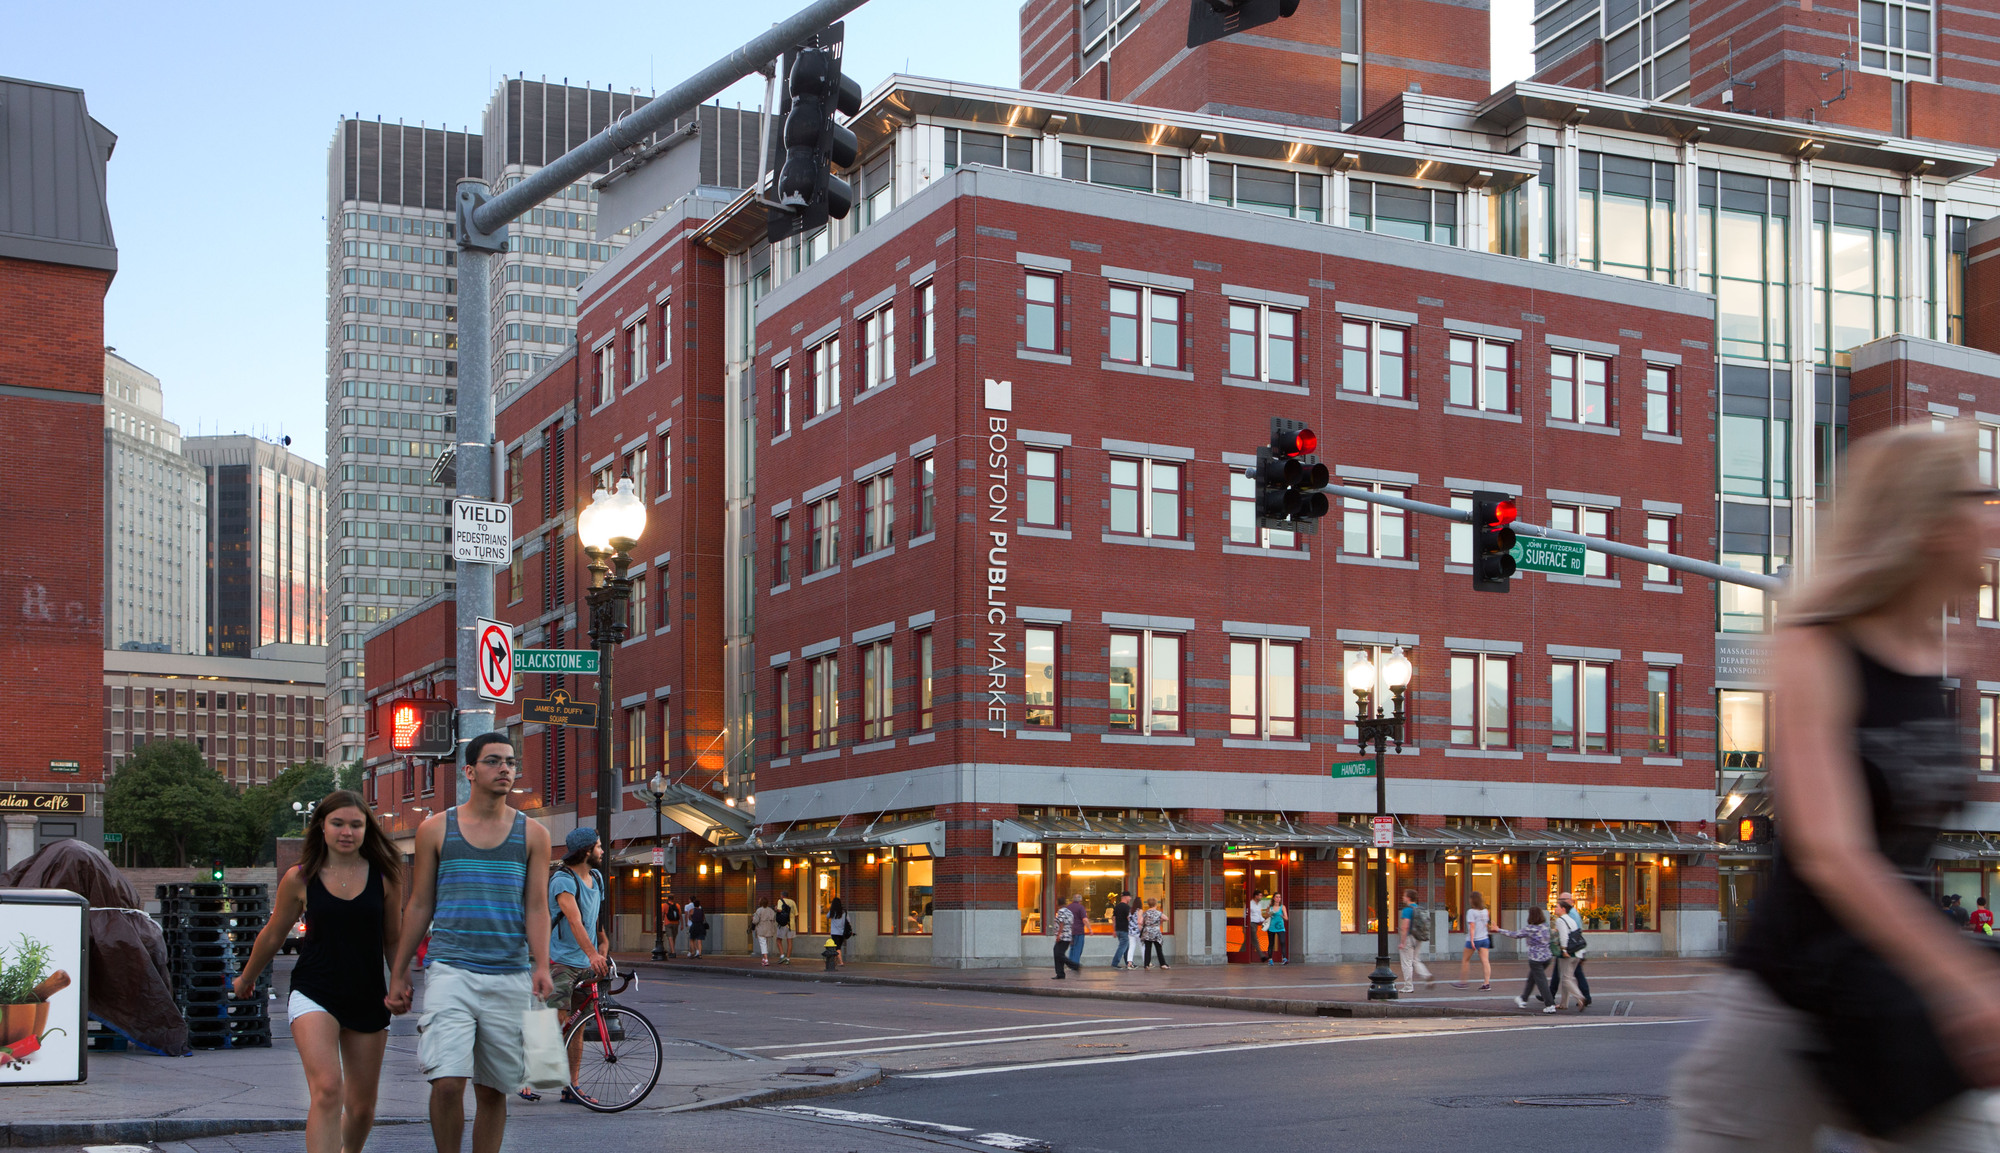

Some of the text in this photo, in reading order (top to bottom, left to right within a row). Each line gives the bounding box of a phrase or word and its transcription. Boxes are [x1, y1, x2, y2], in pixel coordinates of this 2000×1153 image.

[458, 505, 507, 523] YIELD
[477, 523, 488, 531] TO
[456, 531, 507, 546] PEDESTRIANS
[459, 546, 505, 559] ON TURNS
[1526, 541, 1541, 549] JOHN
[1549, 544, 1584, 554] FITZGERALD
[1525, 549, 1581, 570] SURFACE RD
[988, 417, 1008, 738] BOSTON PUBLIC MARKET
[514, 653, 595, 669] BLACKSTONE ST
[534, 705, 555, 713] JAMES
[563, 707, 584, 715] DUFFY
[549, 715, 569, 724] SQUARE
[1341, 764, 1366, 776] HANOVER
[0, 794, 70, 810] alian Caffé
